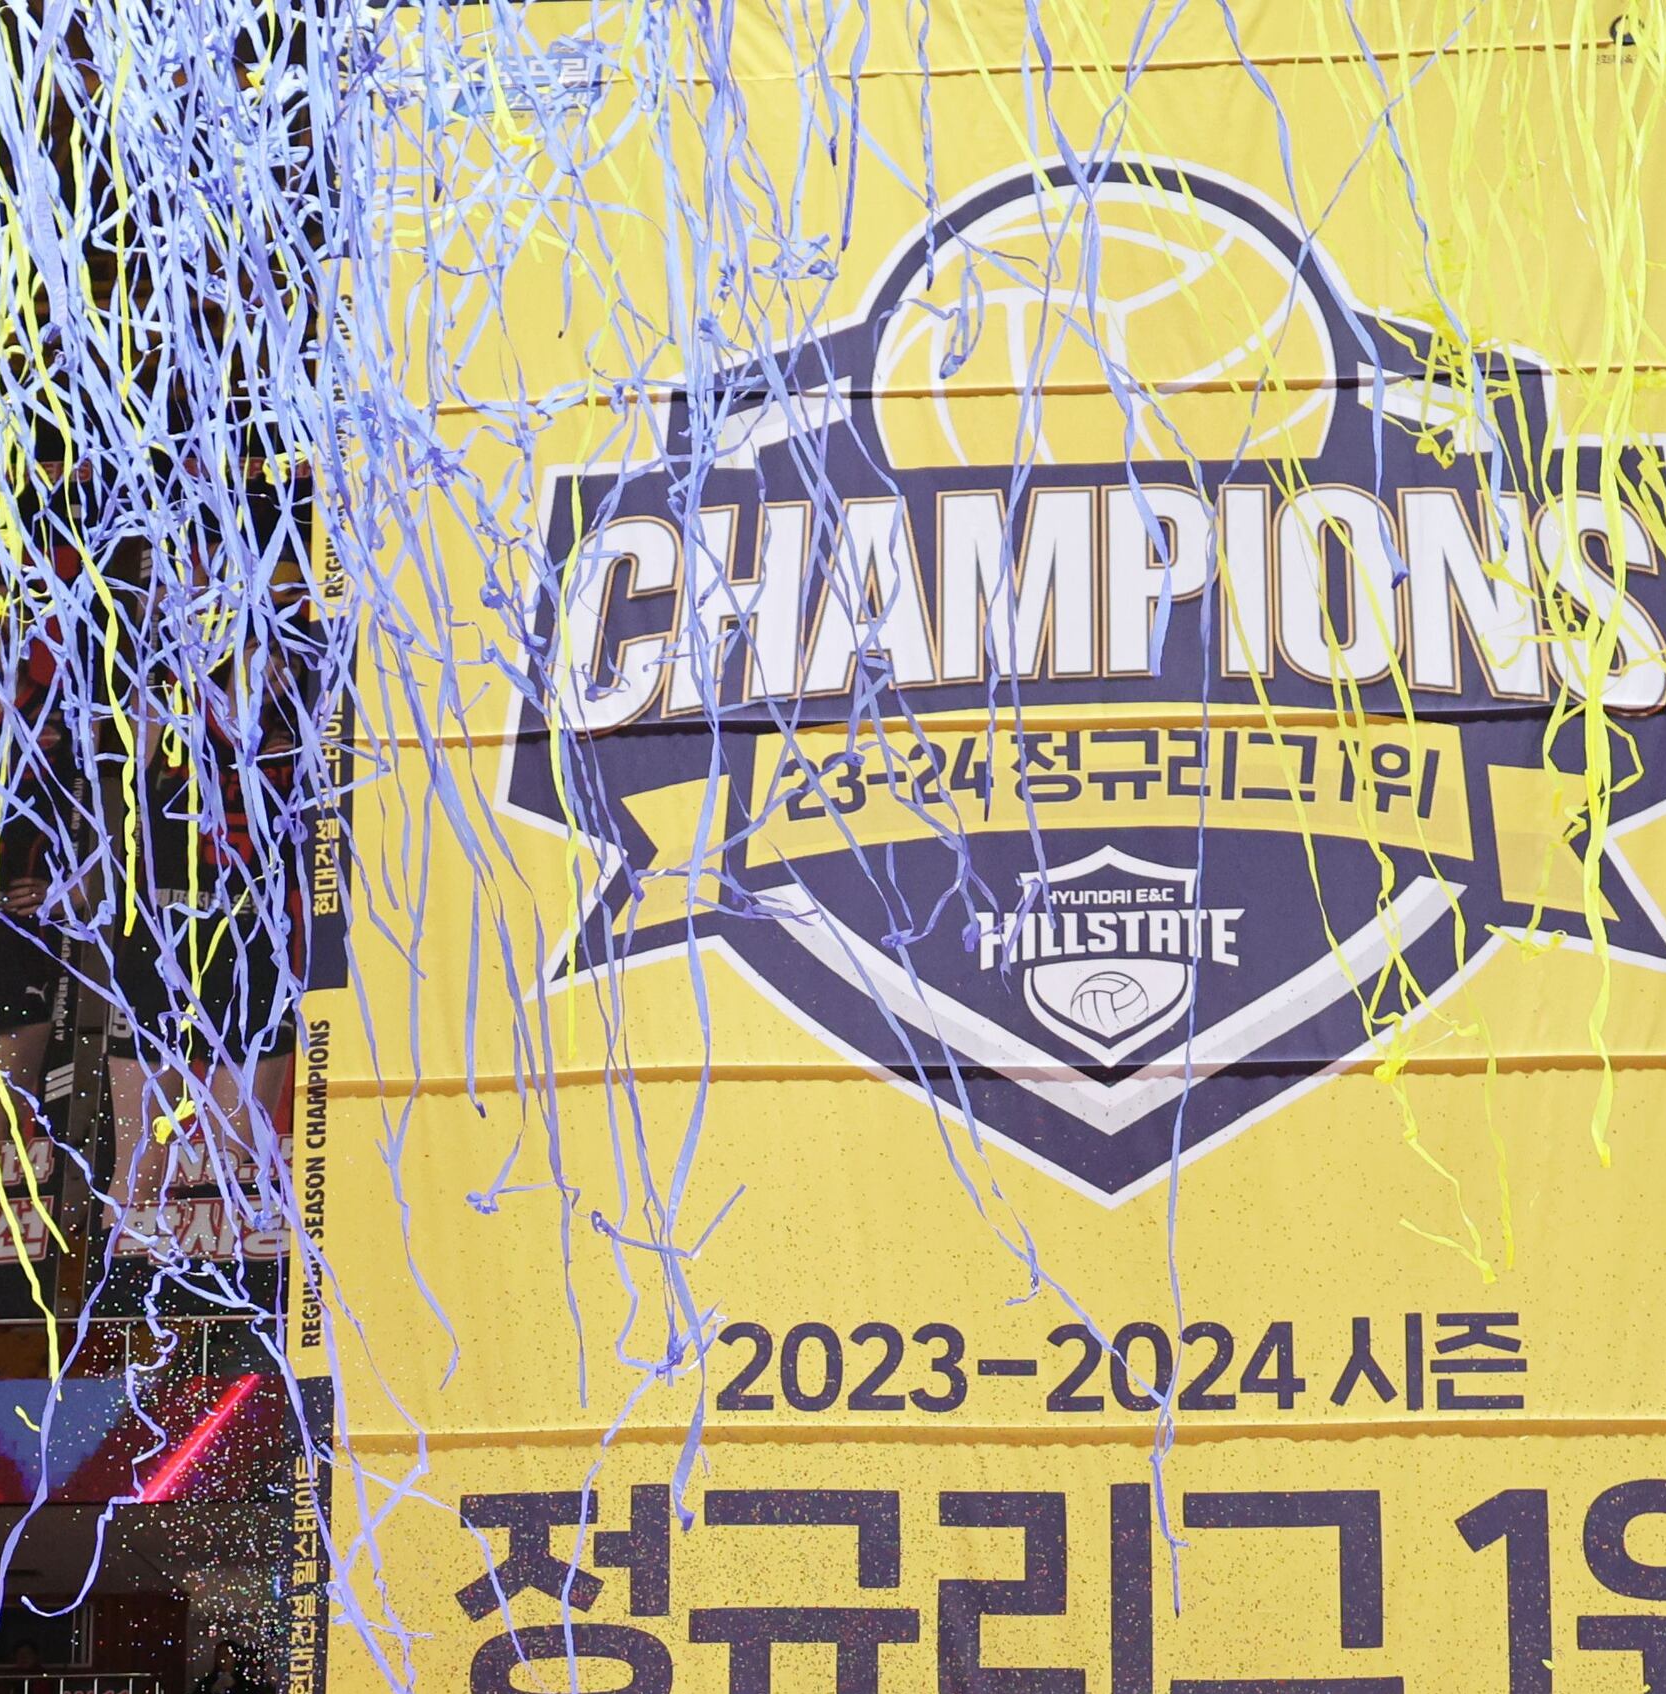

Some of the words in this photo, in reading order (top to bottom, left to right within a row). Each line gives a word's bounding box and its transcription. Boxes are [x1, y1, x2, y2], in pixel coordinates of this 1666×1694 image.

[784, 740, 993, 822] 23-24
[1010, 727, 1320, 804] 정규리그
[1336, 735, 1438, 821] 1위
[312, 819, 339, 916] 현대건설
[1047, 888, 1131, 905] HYUNDAI
[1135, 887, 1175, 904] E&C
[975, 908, 1245, 970] HILLSTATE
[306, 1019, 330, 1151] CHAMPIONS
[304, 1156, 326, 1241] SEASON
[301, 1240, 324, 1348] REGULAR
[717, 1318, 1305, 1414] 2023-2024
[1331, 1311, 1526, 1413] 시즌
[293, 1453, 322, 1585] 힐스테이트
